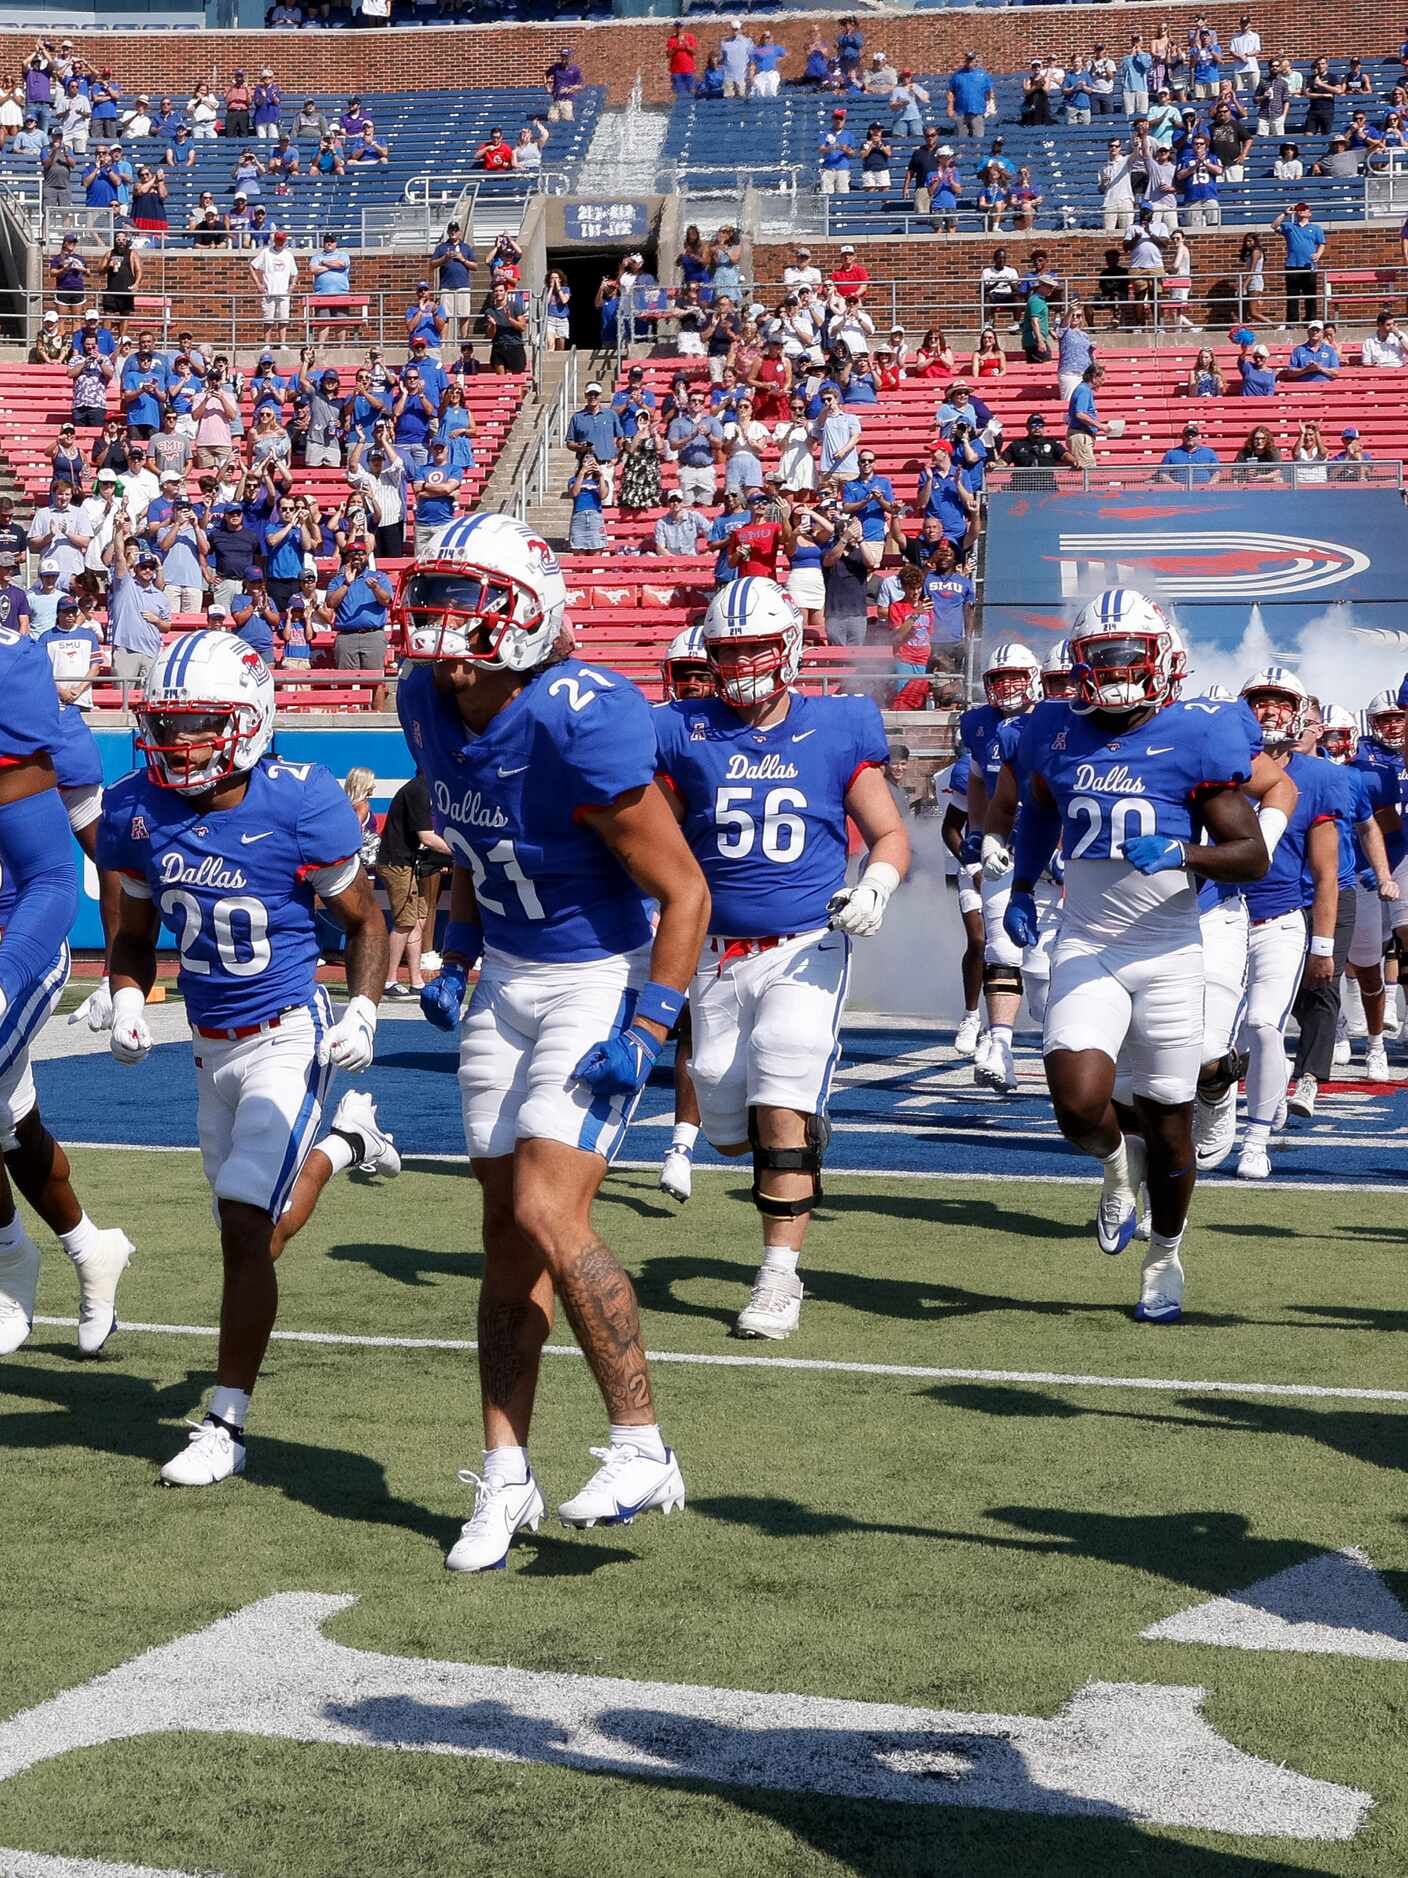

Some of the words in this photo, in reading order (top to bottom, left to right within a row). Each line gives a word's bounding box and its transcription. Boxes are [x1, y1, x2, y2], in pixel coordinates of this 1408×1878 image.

[1192, 173, 1210, 184] 15
[158, 440, 184, 453] SMU
[438, 548, 455, 559] 214
[928, 581, 963, 593] SMU
[58, 641, 81, 650] SMU
[548, 667, 616, 713] 21
[725, 754, 799, 780] Dallas
[1072, 763, 1146, 794] Dallas
[434, 779, 509, 828] Dallas
[714, 786, 807, 864] 56
[1067, 796, 1157, 860] 20
[159, 852, 247, 890] Dallas
[442, 826, 546, 920] 21
[160, 888, 269, 977] 20
